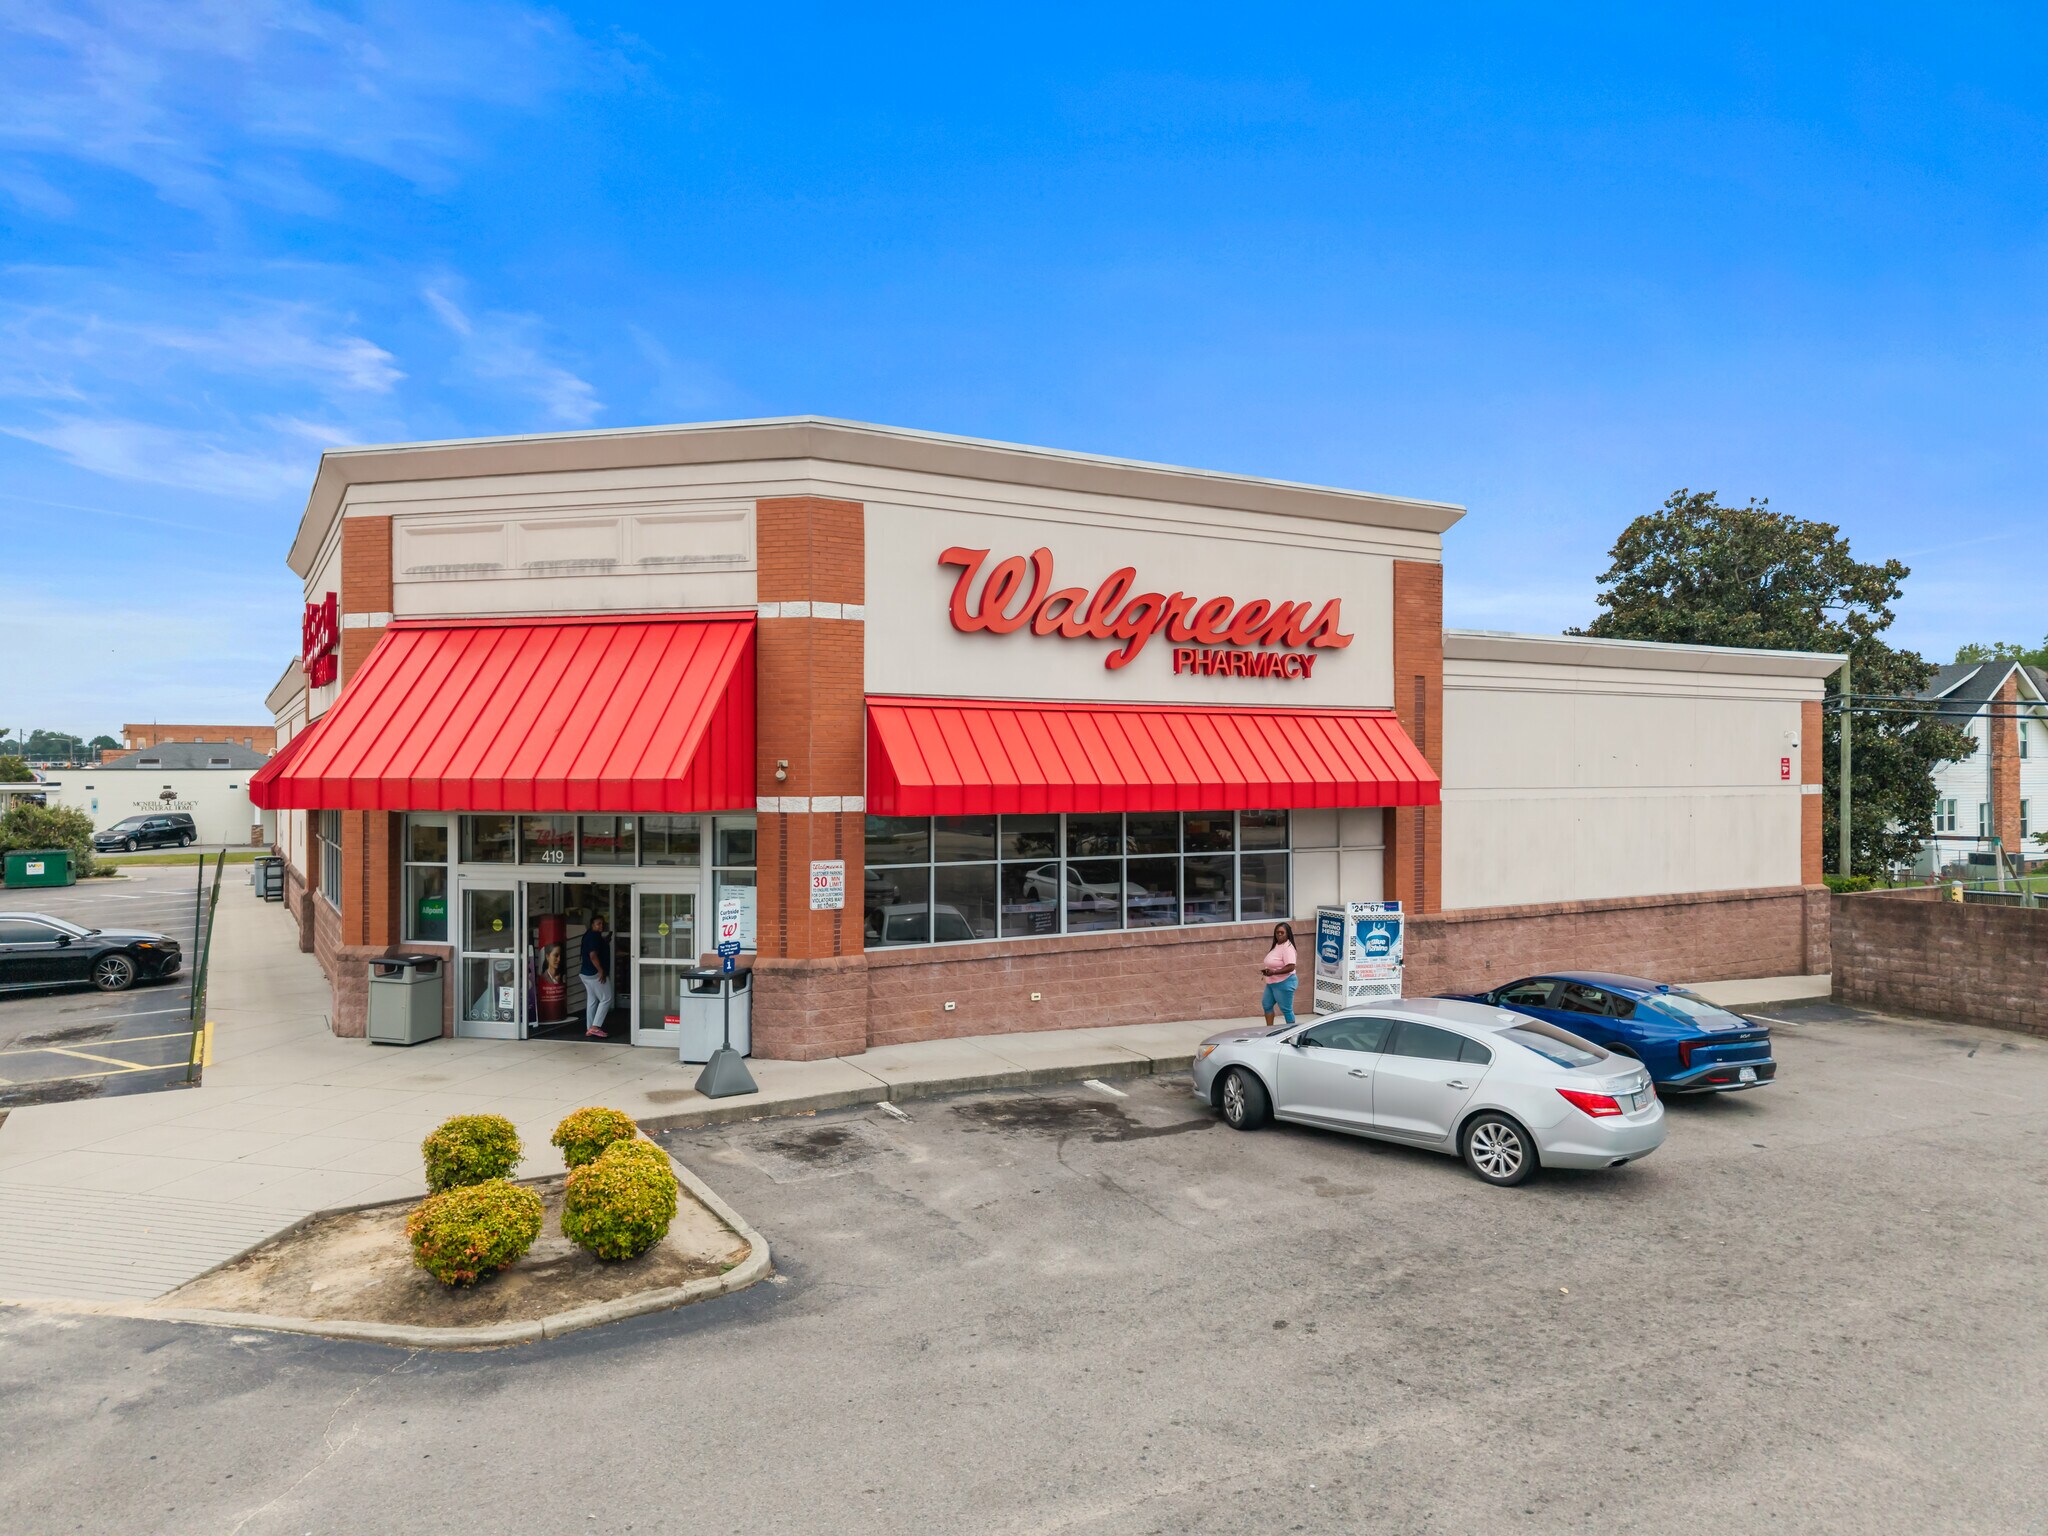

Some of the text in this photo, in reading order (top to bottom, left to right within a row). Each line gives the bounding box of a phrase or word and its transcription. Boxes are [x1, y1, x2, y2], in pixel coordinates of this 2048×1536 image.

[938, 546, 1354, 670] Walgreens
[1173, 648, 1318, 679] PHARMACY
[542, 850, 564, 863] 419
[813, 876, 828, 887] 30
[422, 904, 443, 915] Allpoint
[726, 961, 732, 969] 1
